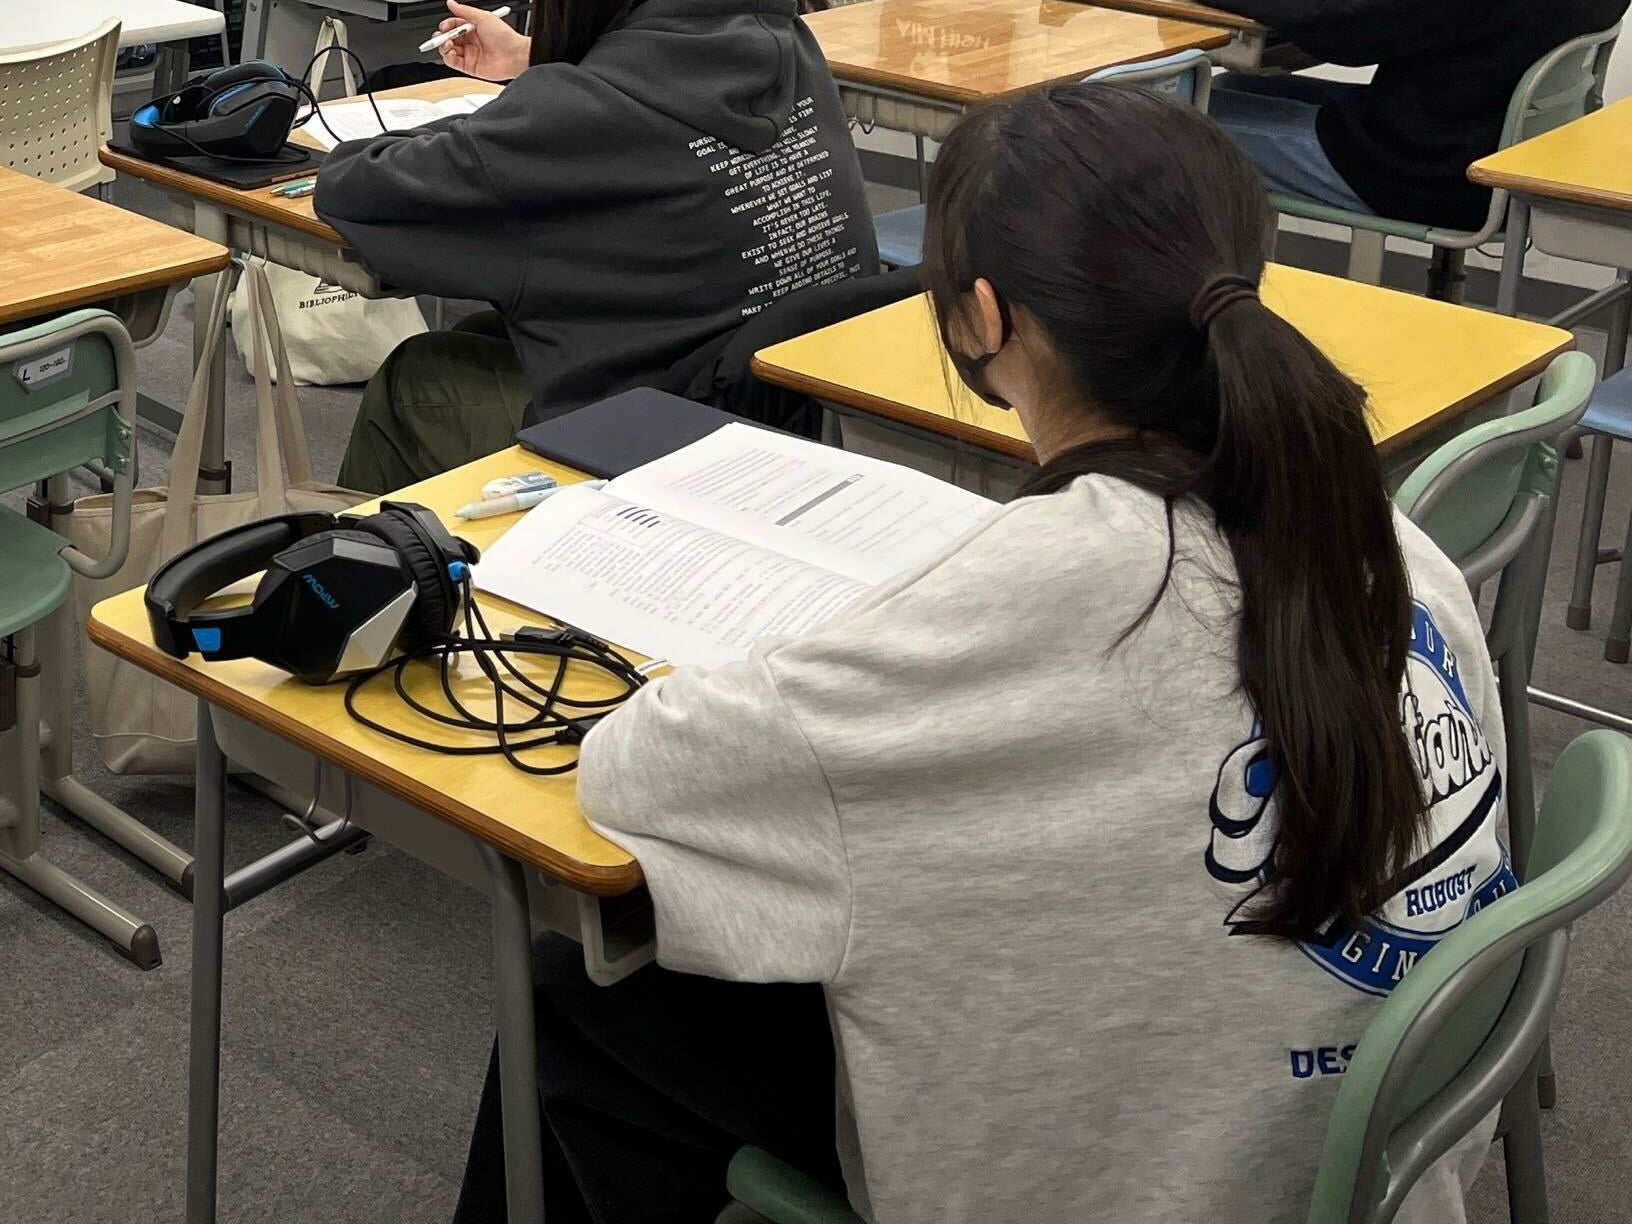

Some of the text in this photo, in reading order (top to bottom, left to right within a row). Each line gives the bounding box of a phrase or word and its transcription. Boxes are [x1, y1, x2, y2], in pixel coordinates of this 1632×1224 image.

[696, 144, 716, 158] GOAL
[709, 160, 729, 173] KEEP
[754, 164, 770, 175] LIFE
[724, 182, 748, 197] GREAT
[731, 196, 767, 215] WHENEVER
[776, 187, 788, 197] SET
[788, 179, 806, 192] GOALS
[806, 174, 819, 185] AND
[818, 168, 834, 180] LIST
[751, 205, 792, 227] ACCOMPLISH
[741, 244, 767, 260] EXIST
[767, 241, 777, 250] TO
[754, 254, 769, 266] AND
[748, 281, 773, 296] WRITE
[22, 368, 30, 382] L
